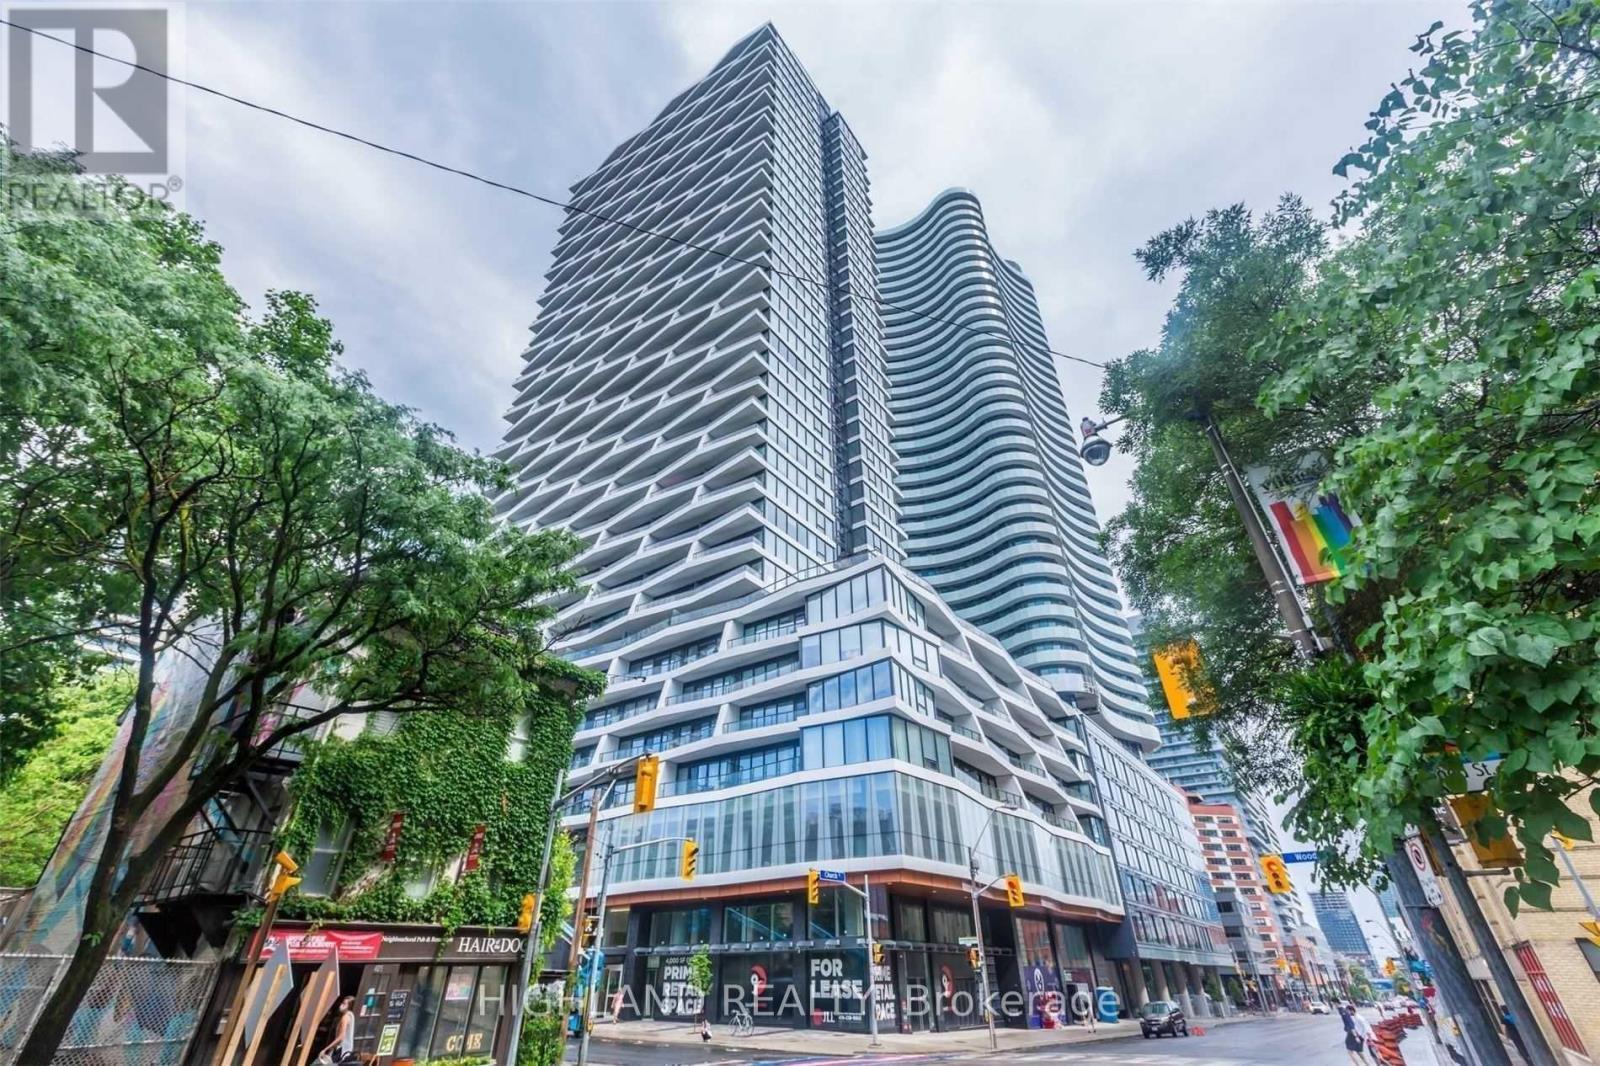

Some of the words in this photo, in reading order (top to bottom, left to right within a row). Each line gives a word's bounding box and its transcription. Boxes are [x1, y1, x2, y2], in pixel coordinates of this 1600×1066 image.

[457, 937, 495, 953] HAIR
[664, 966, 693, 980] PRIM
[811, 959, 843, 977] FOR
[810, 980, 863, 999] LEASE
[875, 984, 896, 1000] ETAIL
[875, 1002, 896, 1020] PACE
